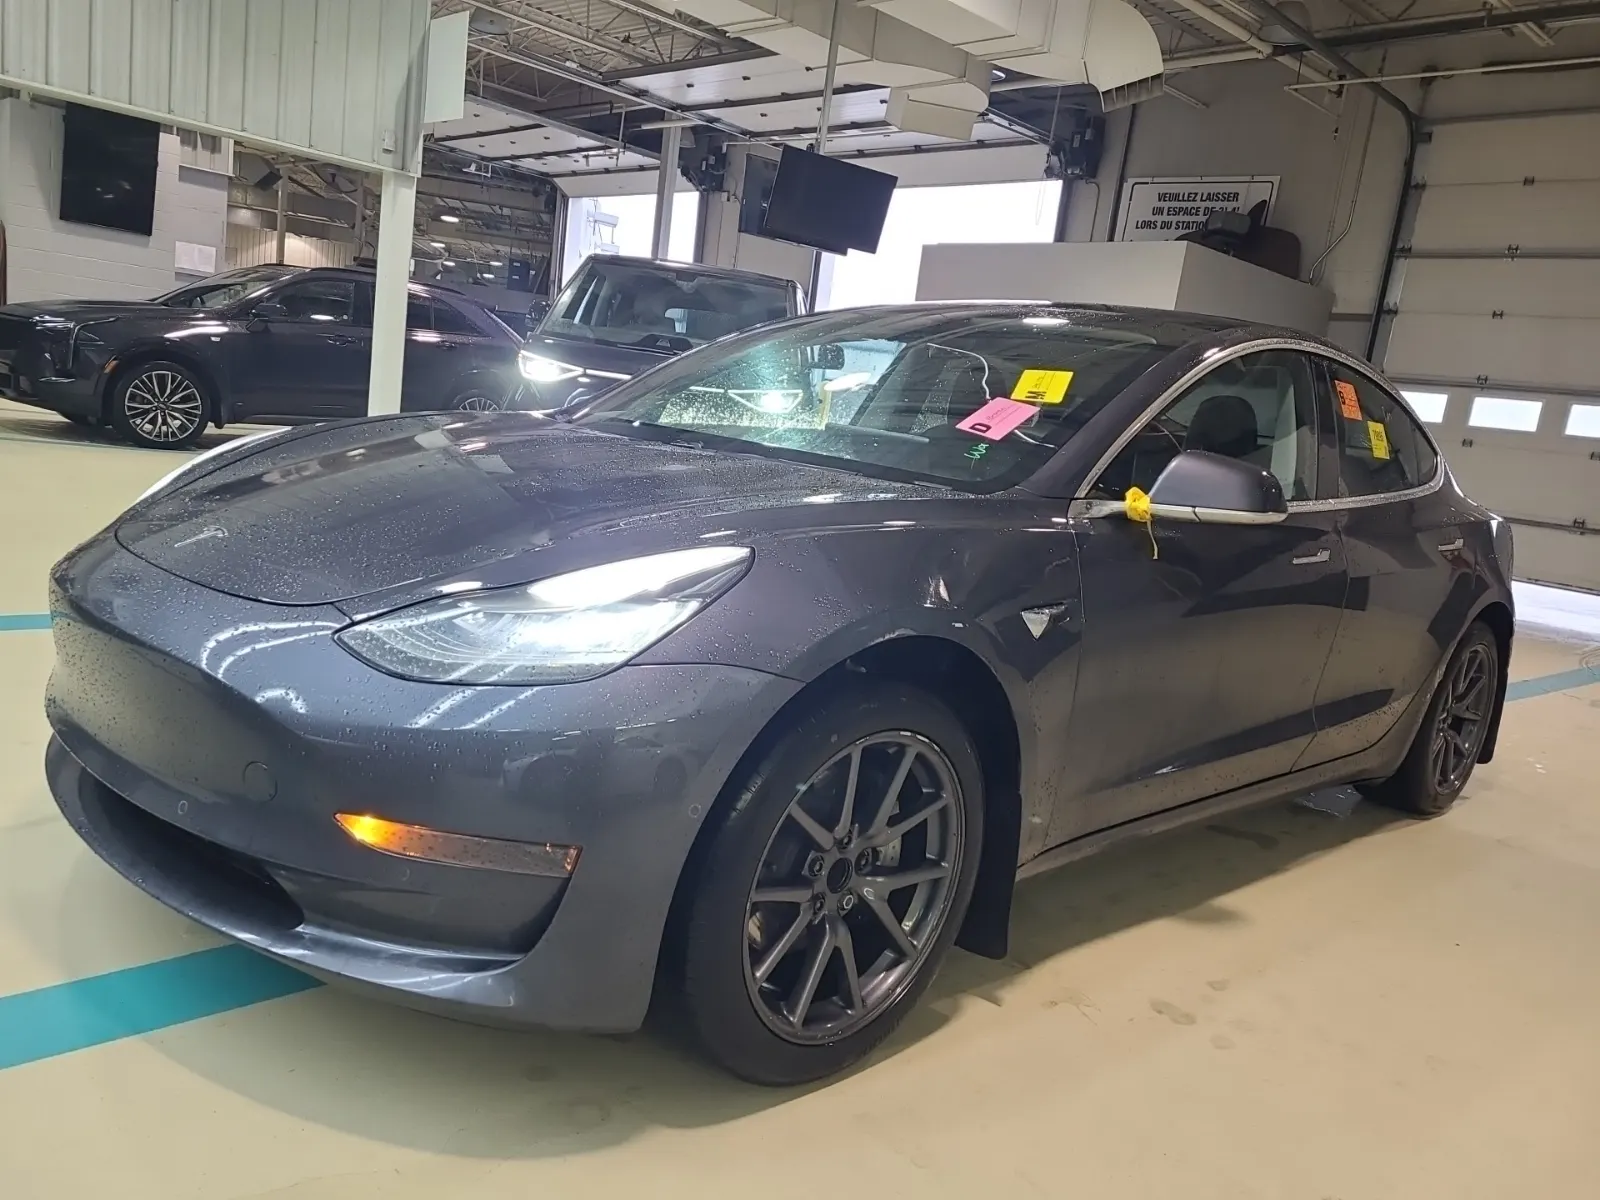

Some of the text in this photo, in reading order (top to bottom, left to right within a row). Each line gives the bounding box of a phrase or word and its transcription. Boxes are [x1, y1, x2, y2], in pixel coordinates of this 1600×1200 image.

[1157, 191, 1240, 202] VEUILLEZ LAISSER
[1151, 206, 1165, 216] UN
[1166, 206, 1201, 217] ESPACE
[1135, 220, 1158, 230] LORS
[1159, 220, 1173, 230] DU
[968, 422, 993, 434] D
